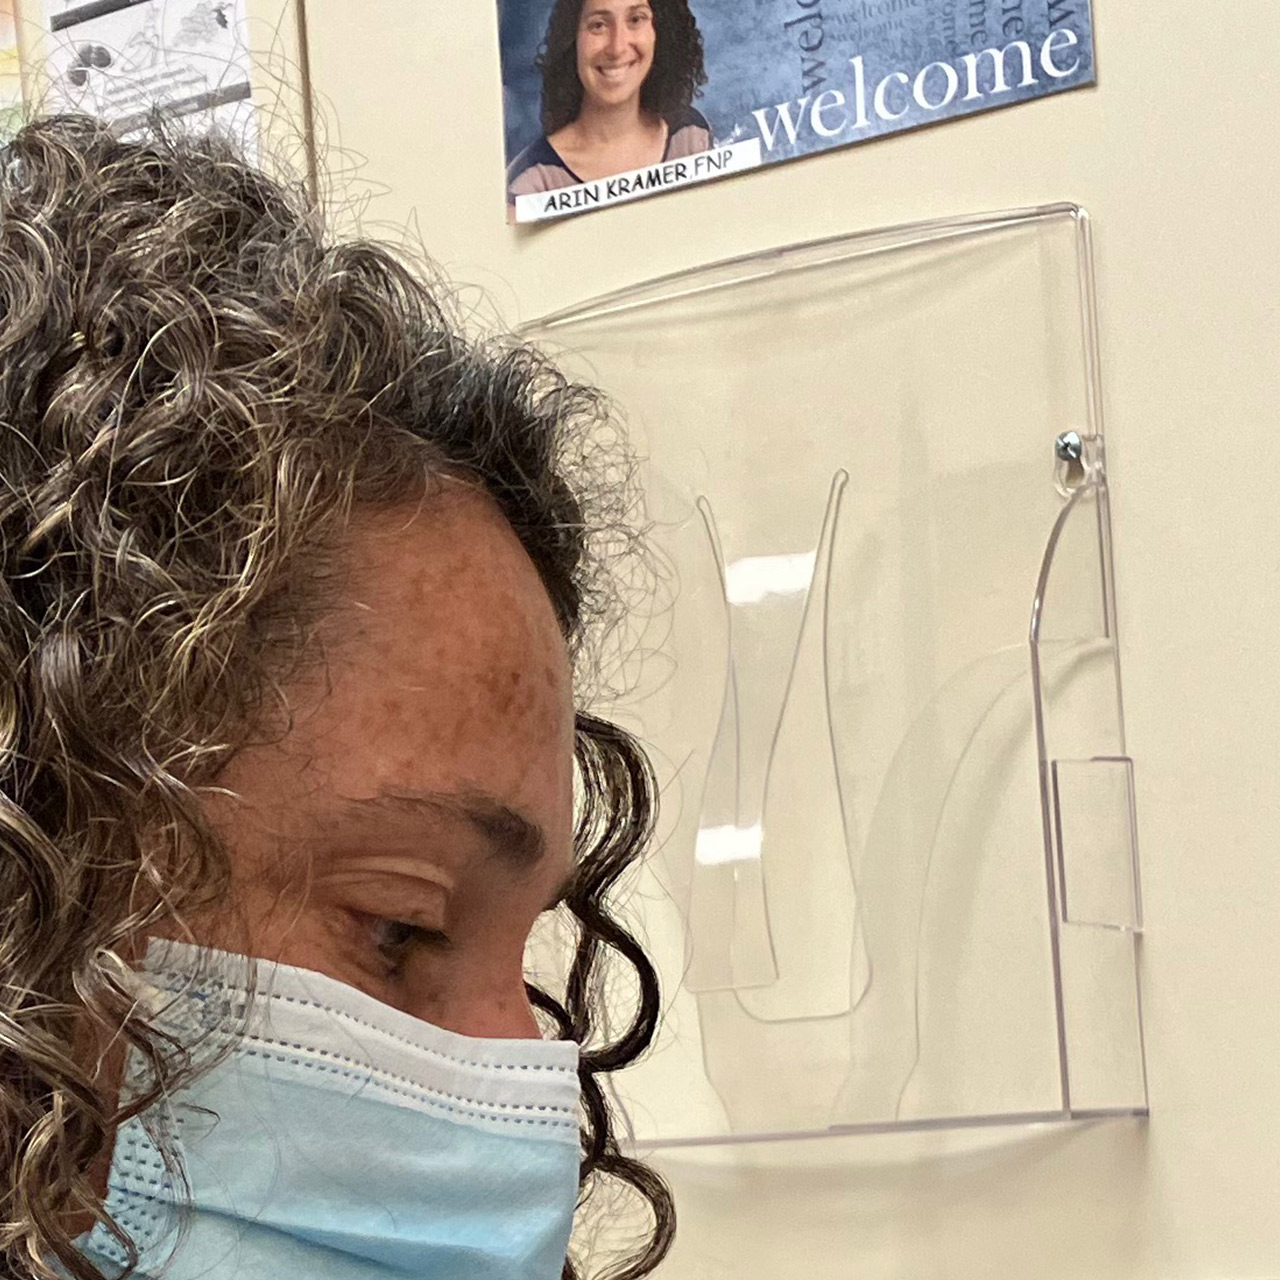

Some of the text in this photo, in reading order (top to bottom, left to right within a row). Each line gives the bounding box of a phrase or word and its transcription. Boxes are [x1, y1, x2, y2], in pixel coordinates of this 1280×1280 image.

[752, 28, 1081, 151] welcome
[544, 185, 600, 213] ARIN
[693, 150, 733, 176] FNP
